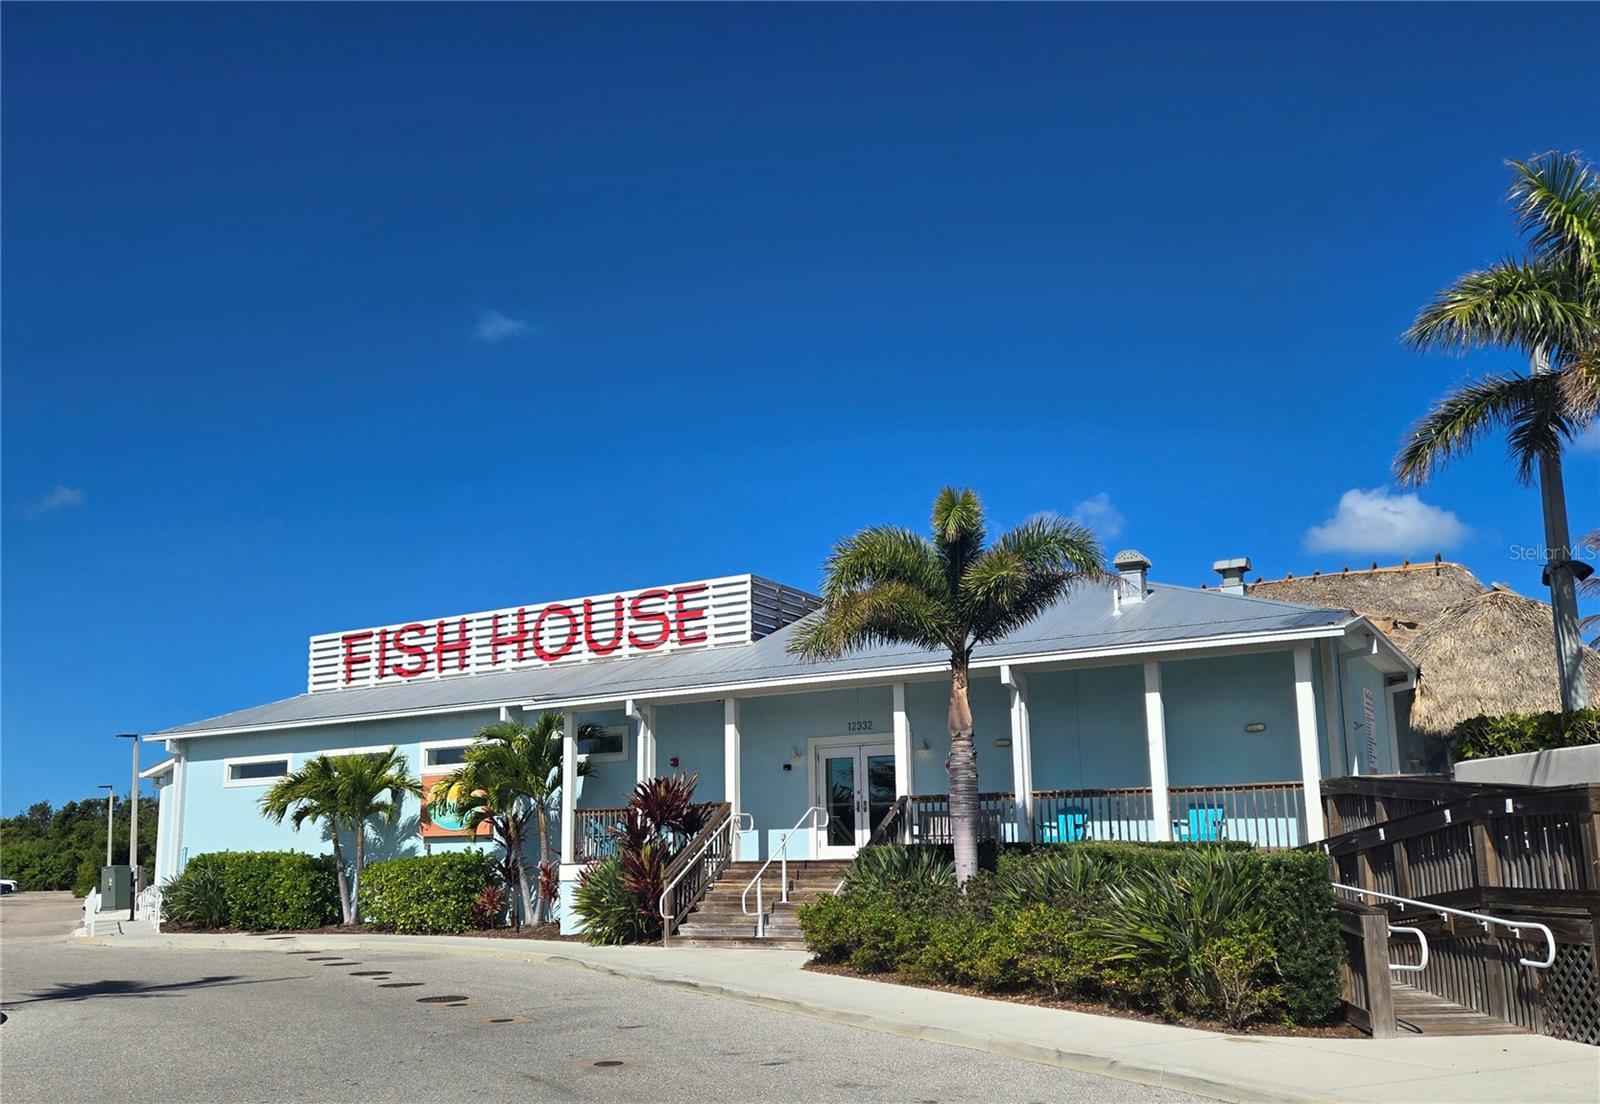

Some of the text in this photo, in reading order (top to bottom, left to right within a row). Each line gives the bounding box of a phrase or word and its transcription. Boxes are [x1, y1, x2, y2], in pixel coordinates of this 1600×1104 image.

[341, 583, 707, 684] FISH HOUSE
[848, 720, 873, 731] 12332
